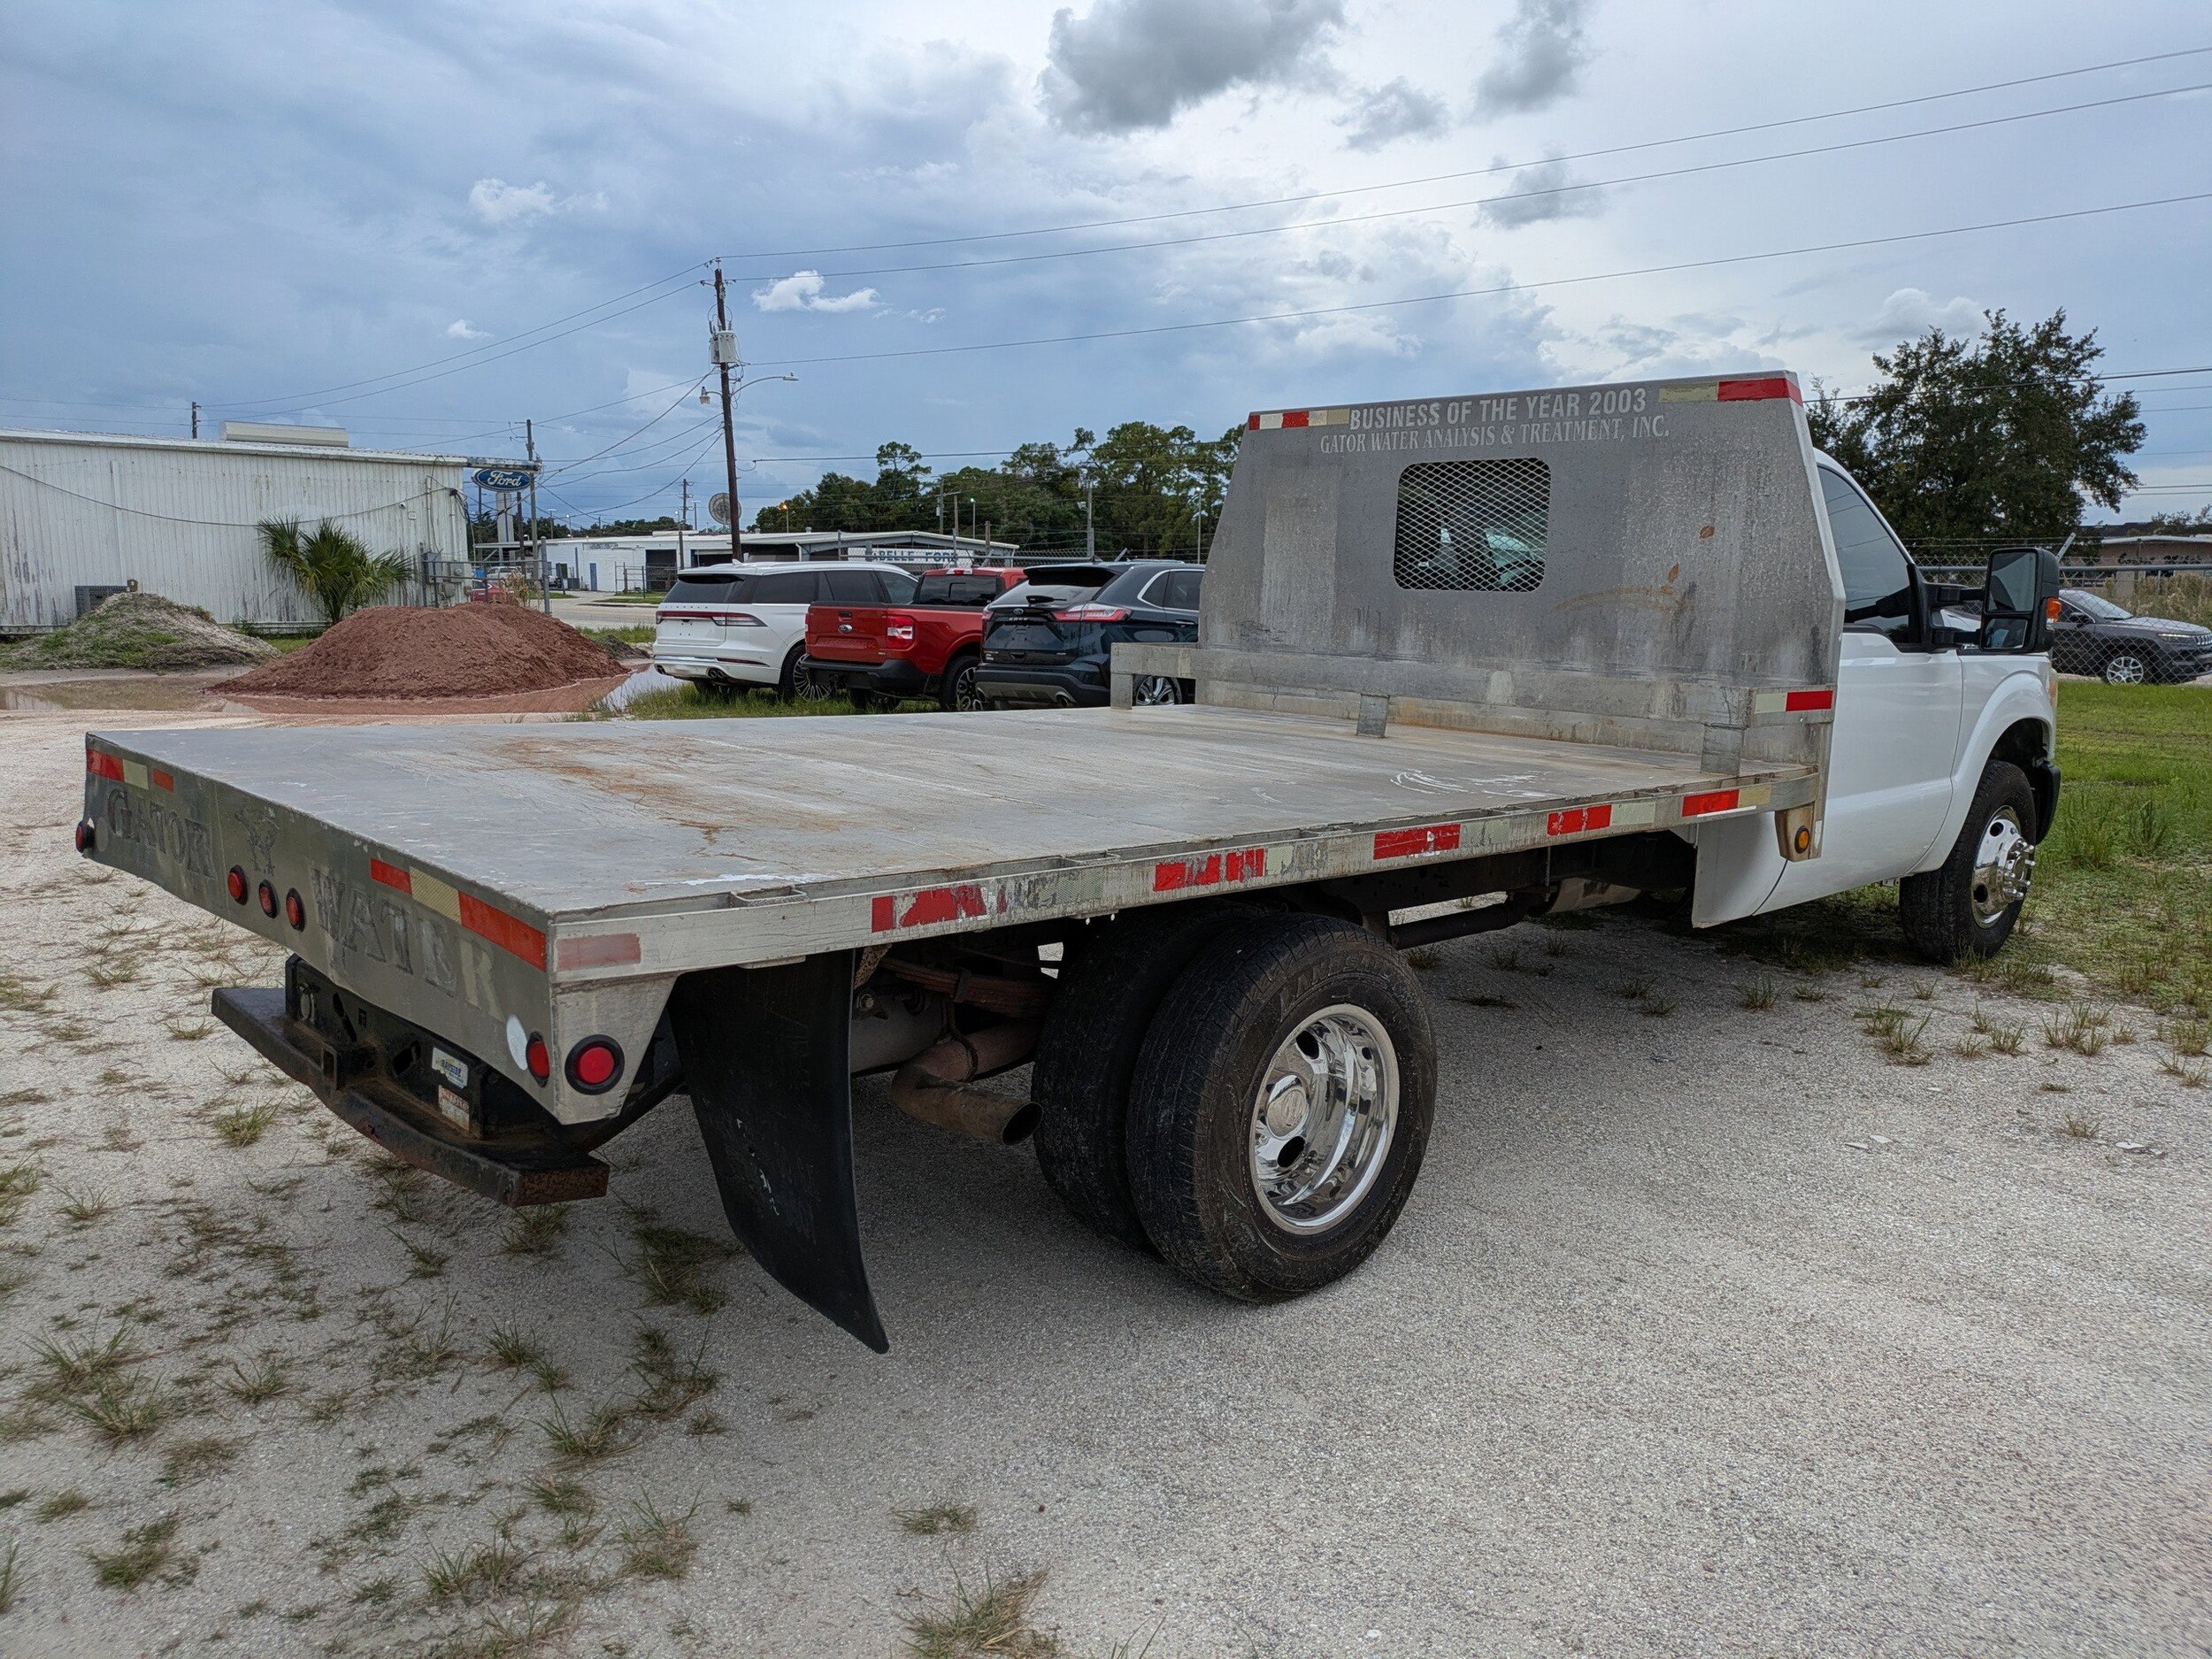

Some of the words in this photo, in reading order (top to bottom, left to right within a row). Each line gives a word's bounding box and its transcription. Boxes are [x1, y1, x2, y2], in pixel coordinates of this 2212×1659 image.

[1349, 402, 1440, 431] BUSINESS
[1447, 400, 1472, 425] OF
[1479, 397, 1518, 423] THE
[1525, 393, 1580, 420] YEAR
[1588, 388, 1647, 416] 2003
[1320, 433, 1366, 454] GATOR
[1371, 430, 1419, 452] WATER
[1423, 425, 1495, 449] ANALYSIS
[1501, 424, 1515, 445] &
[1520, 417, 1624, 444] TREATMENT,
[1632, 414, 1670, 439] INC.
[487, 470, 522, 487] Ford
[311, 866, 503, 1023] WATER
